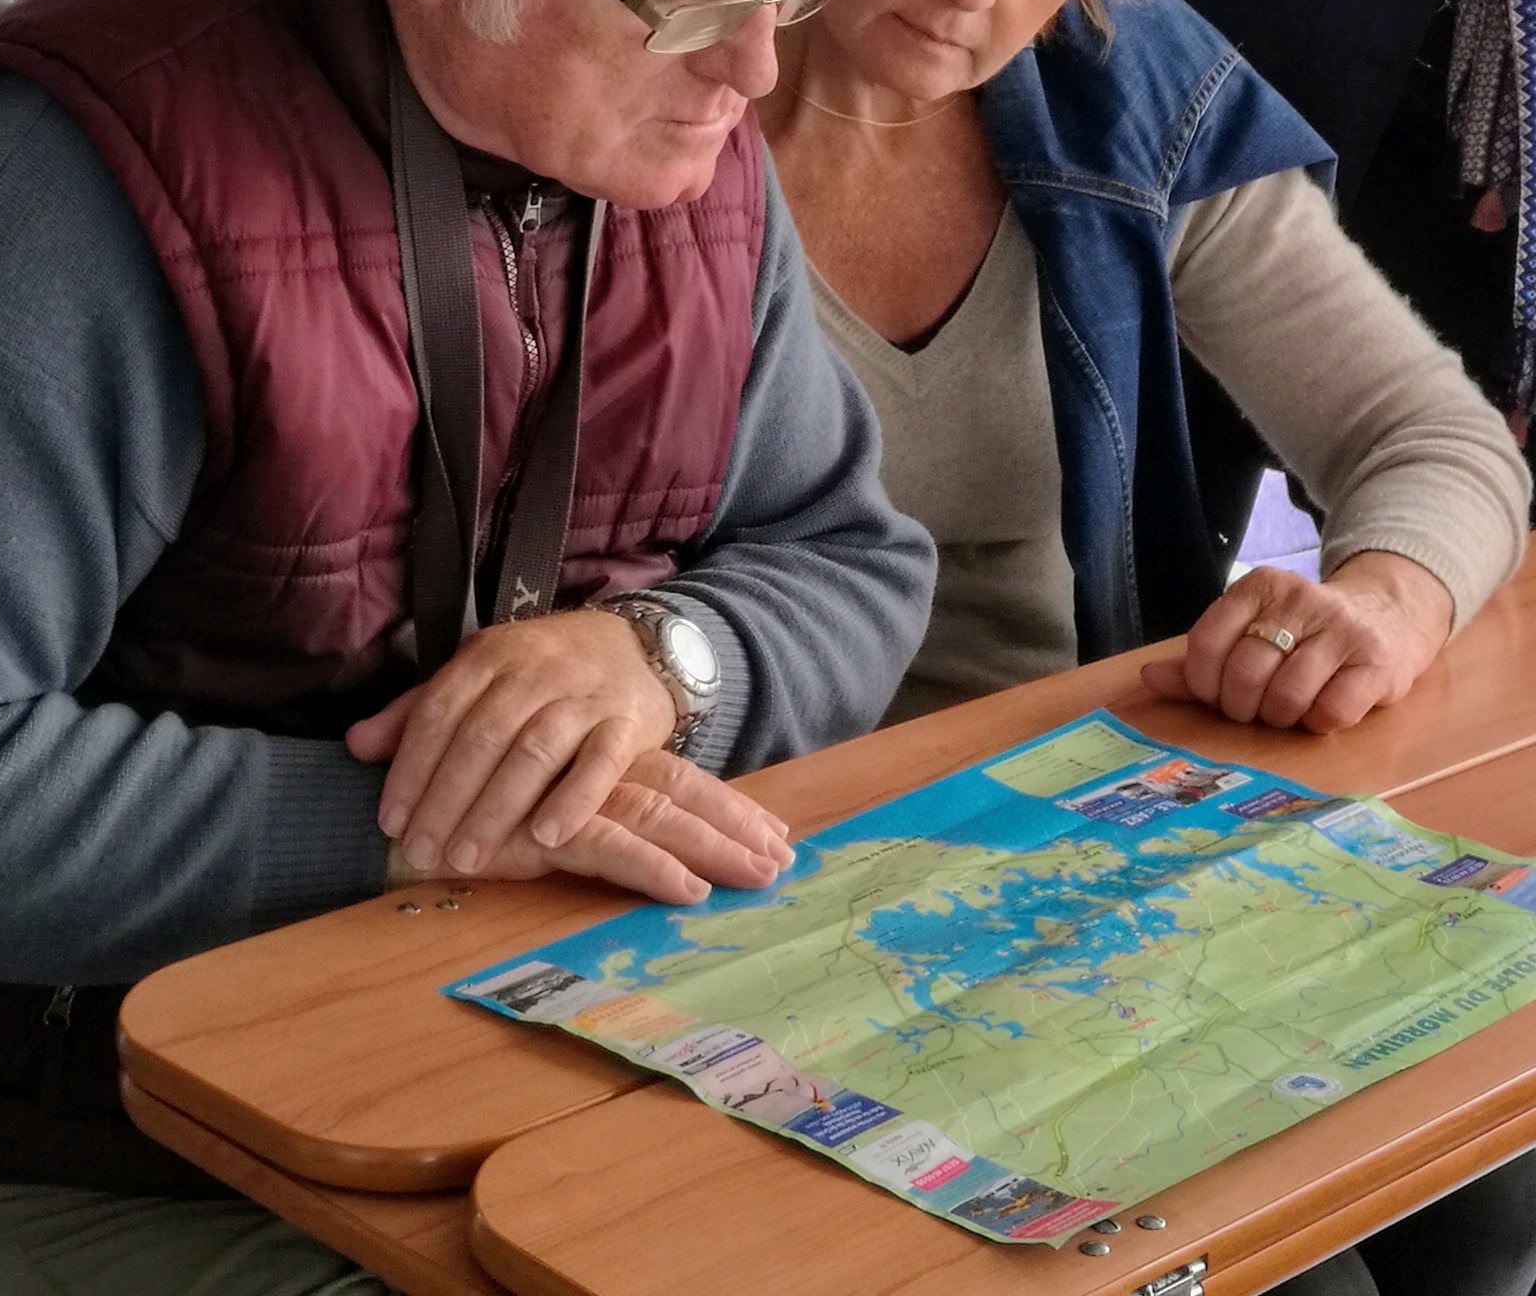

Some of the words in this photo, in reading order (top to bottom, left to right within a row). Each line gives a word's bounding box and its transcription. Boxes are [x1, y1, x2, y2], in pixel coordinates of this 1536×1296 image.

[1452, 988, 1492, 1011] DU
[1341, 1006, 1459, 1071] MORBIHAN
[890, 1138, 936, 1167] NAVIX
